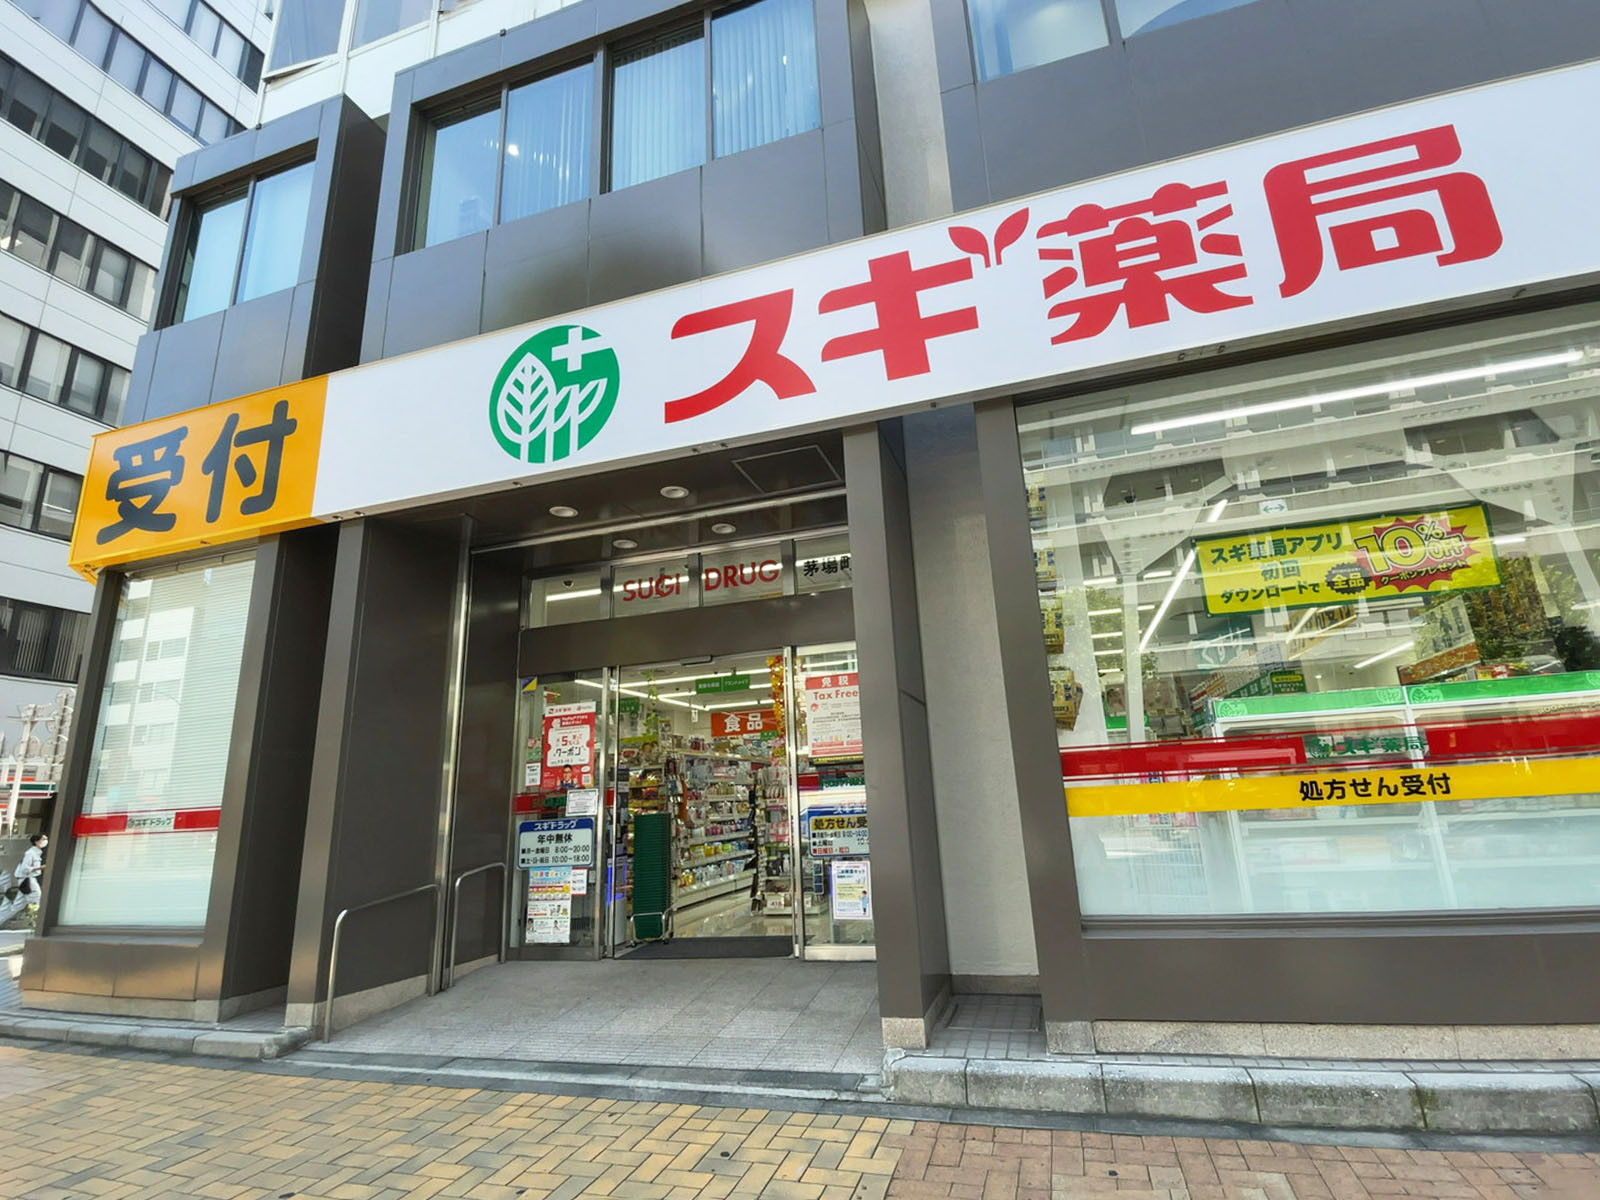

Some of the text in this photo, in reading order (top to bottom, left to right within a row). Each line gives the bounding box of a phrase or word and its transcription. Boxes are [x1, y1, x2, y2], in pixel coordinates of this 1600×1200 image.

[664, 124, 1504, 424] スギ薬局
[96, 400, 298, 545] 受付
[1211, 532, 1343, 565] スギ薬局アプリ
[622, 559, 780, 602] SUGI DRUG
[1260, 558, 1301, 581] 初回
[1331, 571, 1366, 590] 全品
[1220, 580, 1321, 604] ダウンロードで
[813, 689, 859, 700] Tax Free
[724, 712, 764, 733] 食品
[1299, 772, 1451, 802] 処方せん受付
[533, 820, 577, 831] スギドラッグ
[537, 832, 573, 845] 年中無休
